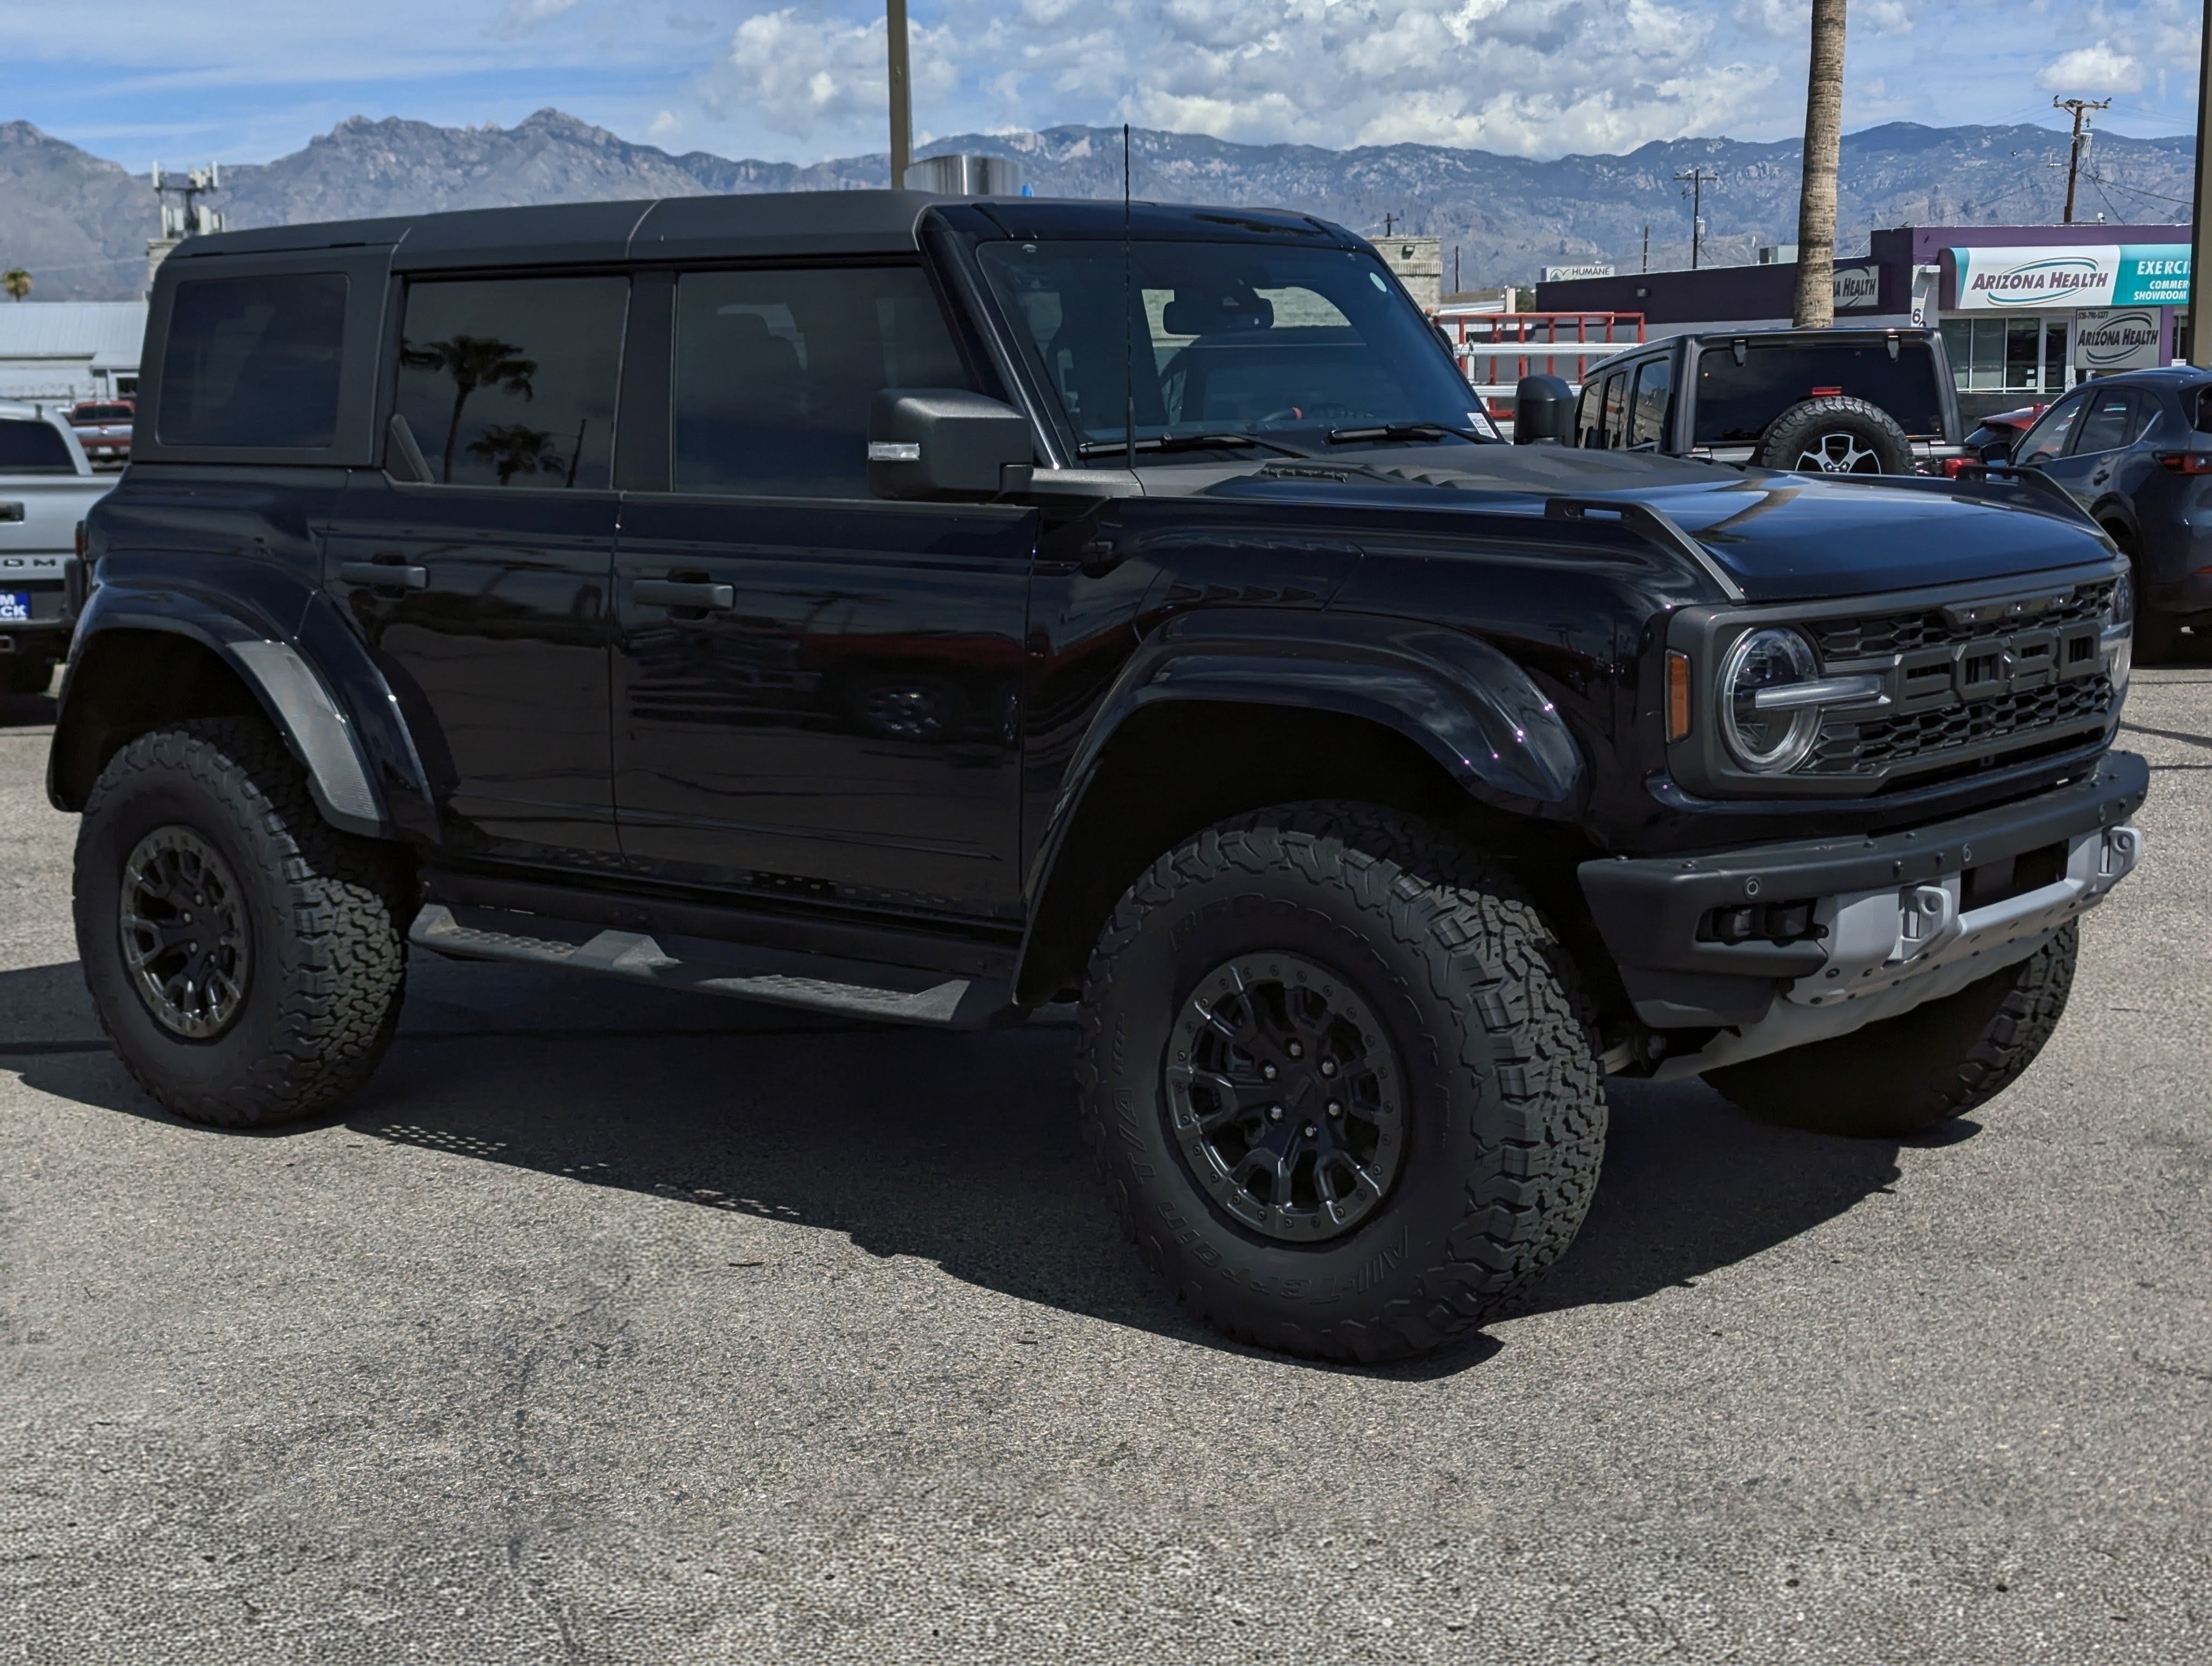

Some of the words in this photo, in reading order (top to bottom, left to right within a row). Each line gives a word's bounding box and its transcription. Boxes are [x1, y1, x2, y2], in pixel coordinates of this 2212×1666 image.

[1843, 278, 1876, 297] HEALTH
[1971, 273, 2044, 290] ARIZONA
[2049, 272, 2108, 288] HEALTH
[2150, 280, 2190, 290] COMMER
[2134, 291, 2187, 300] SHOWROOM
[2078, 330, 2120, 346] ARIZONA
[2122, 328, 2158, 345] HEALTH
[1894, 623, 2101, 715] FORD
